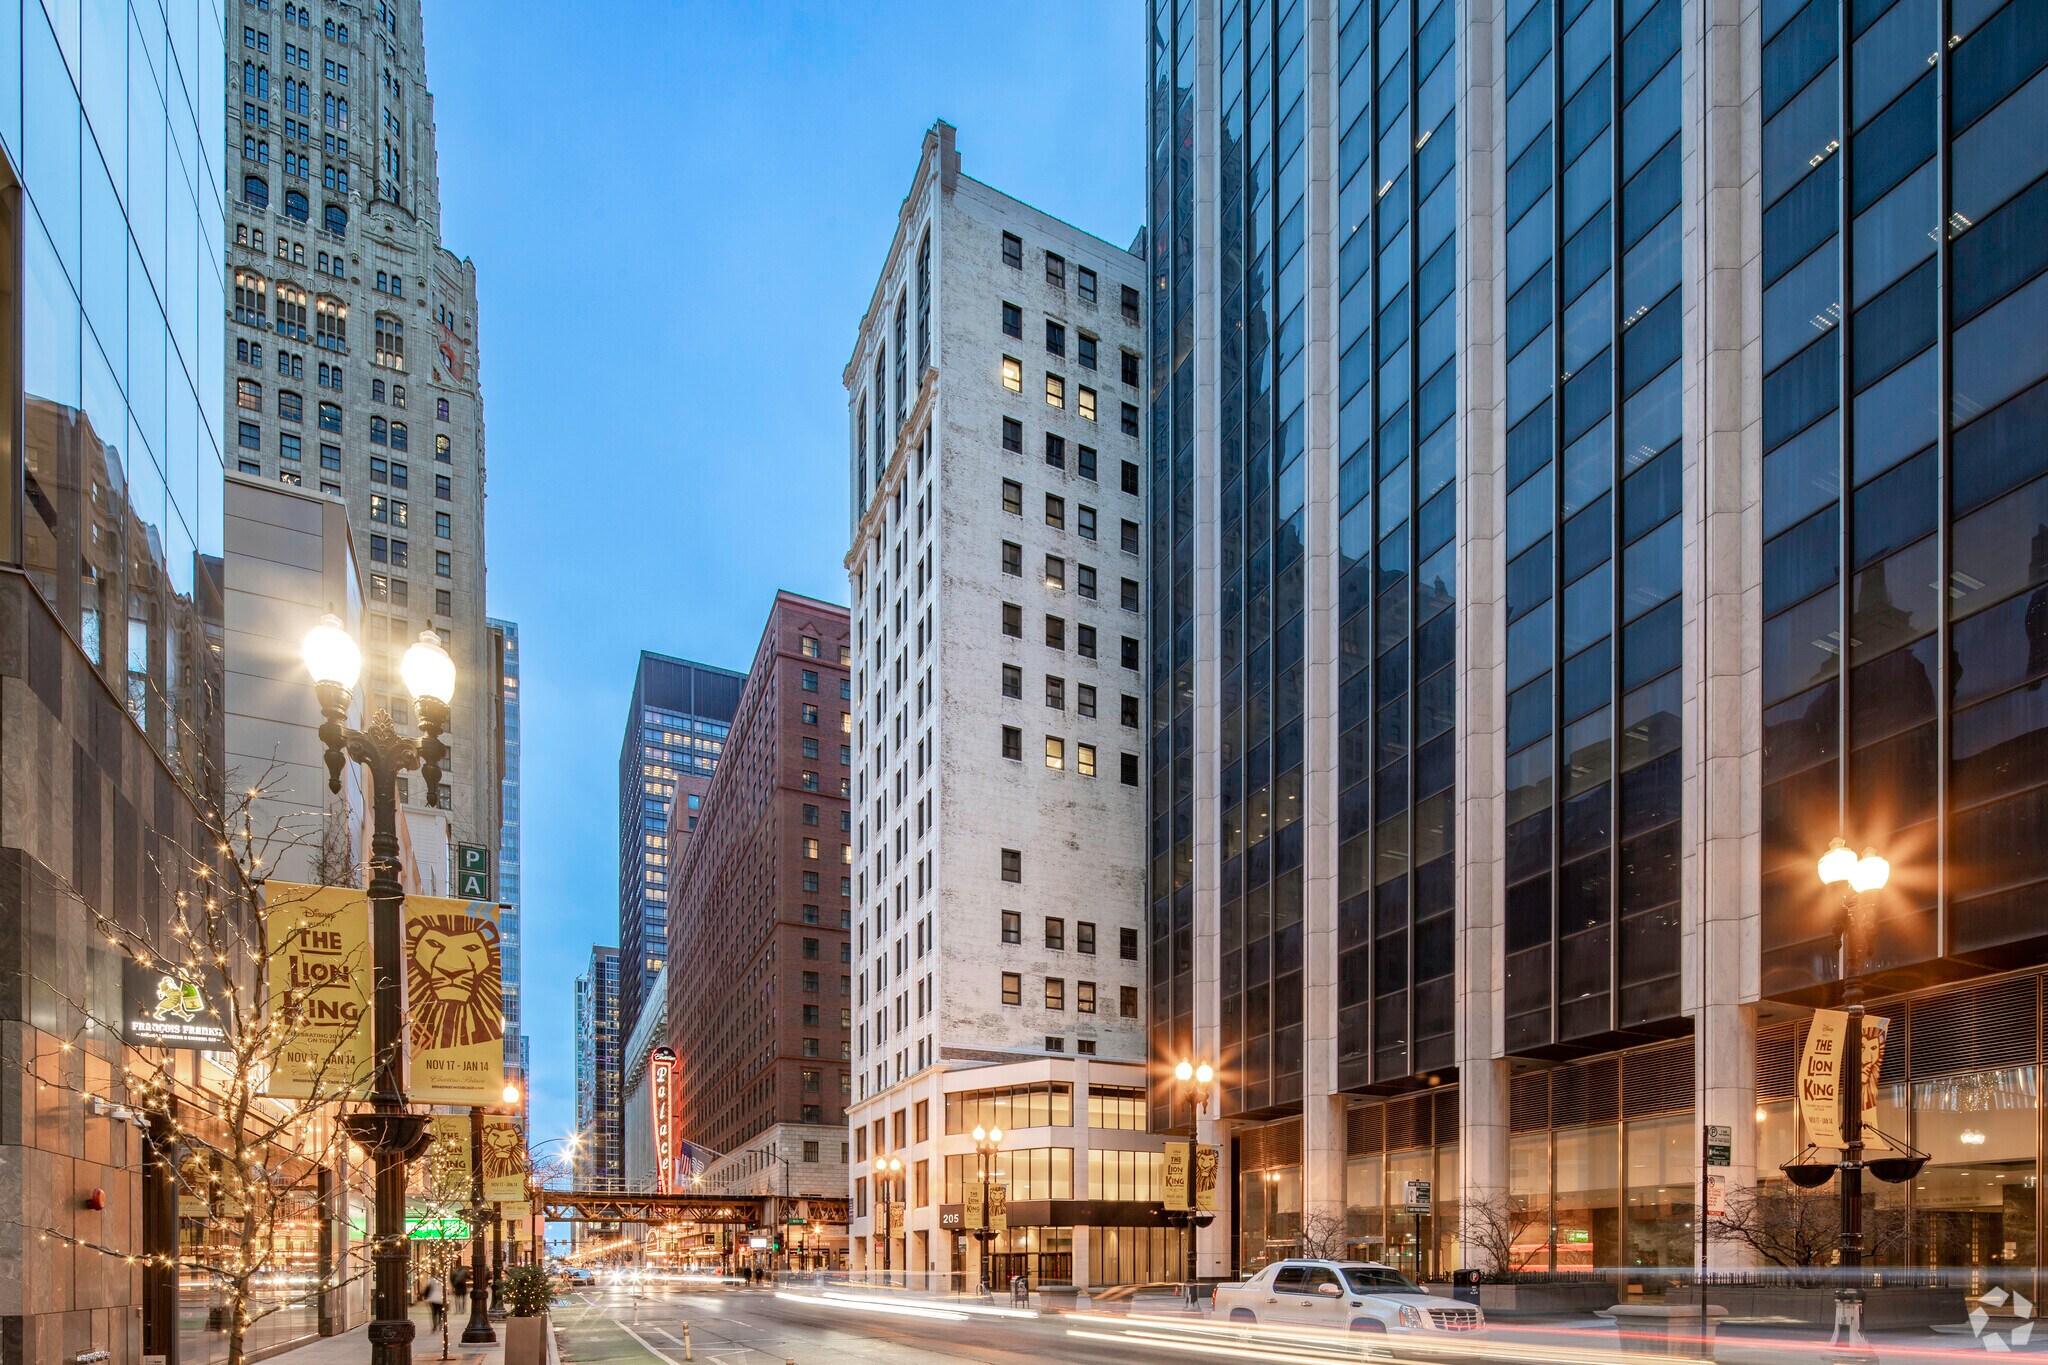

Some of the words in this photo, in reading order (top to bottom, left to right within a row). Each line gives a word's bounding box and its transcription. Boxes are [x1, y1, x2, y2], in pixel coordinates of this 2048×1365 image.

[300, 906, 336, 921] Disney
[299, 928, 342, 950] THE
[289, 955, 350, 988] LION
[283, 990, 359, 1028] KING
[1815, 1039, 1832, 1052] THE
[287, 1052, 308, 1063] NOV
[426, 1059, 444, 1070] NOV
[446, 1060, 455, 1070] 17
[462, 1061, 478, 1071] JAN
[480, 1062, 489, 1071] 14
[1807, 1056, 1833, 1077] LION
[1803, 1078, 1834, 1101] KING
[656, 1066, 669, 1170] Palace
[441, 1132, 459, 1140] THE
[1167, 1164, 1183, 1175] LION
[1165, 1175, 1185, 1187] KING
[966, 1205, 980, 1213] KING
[943, 1214, 959, 1224] 205
